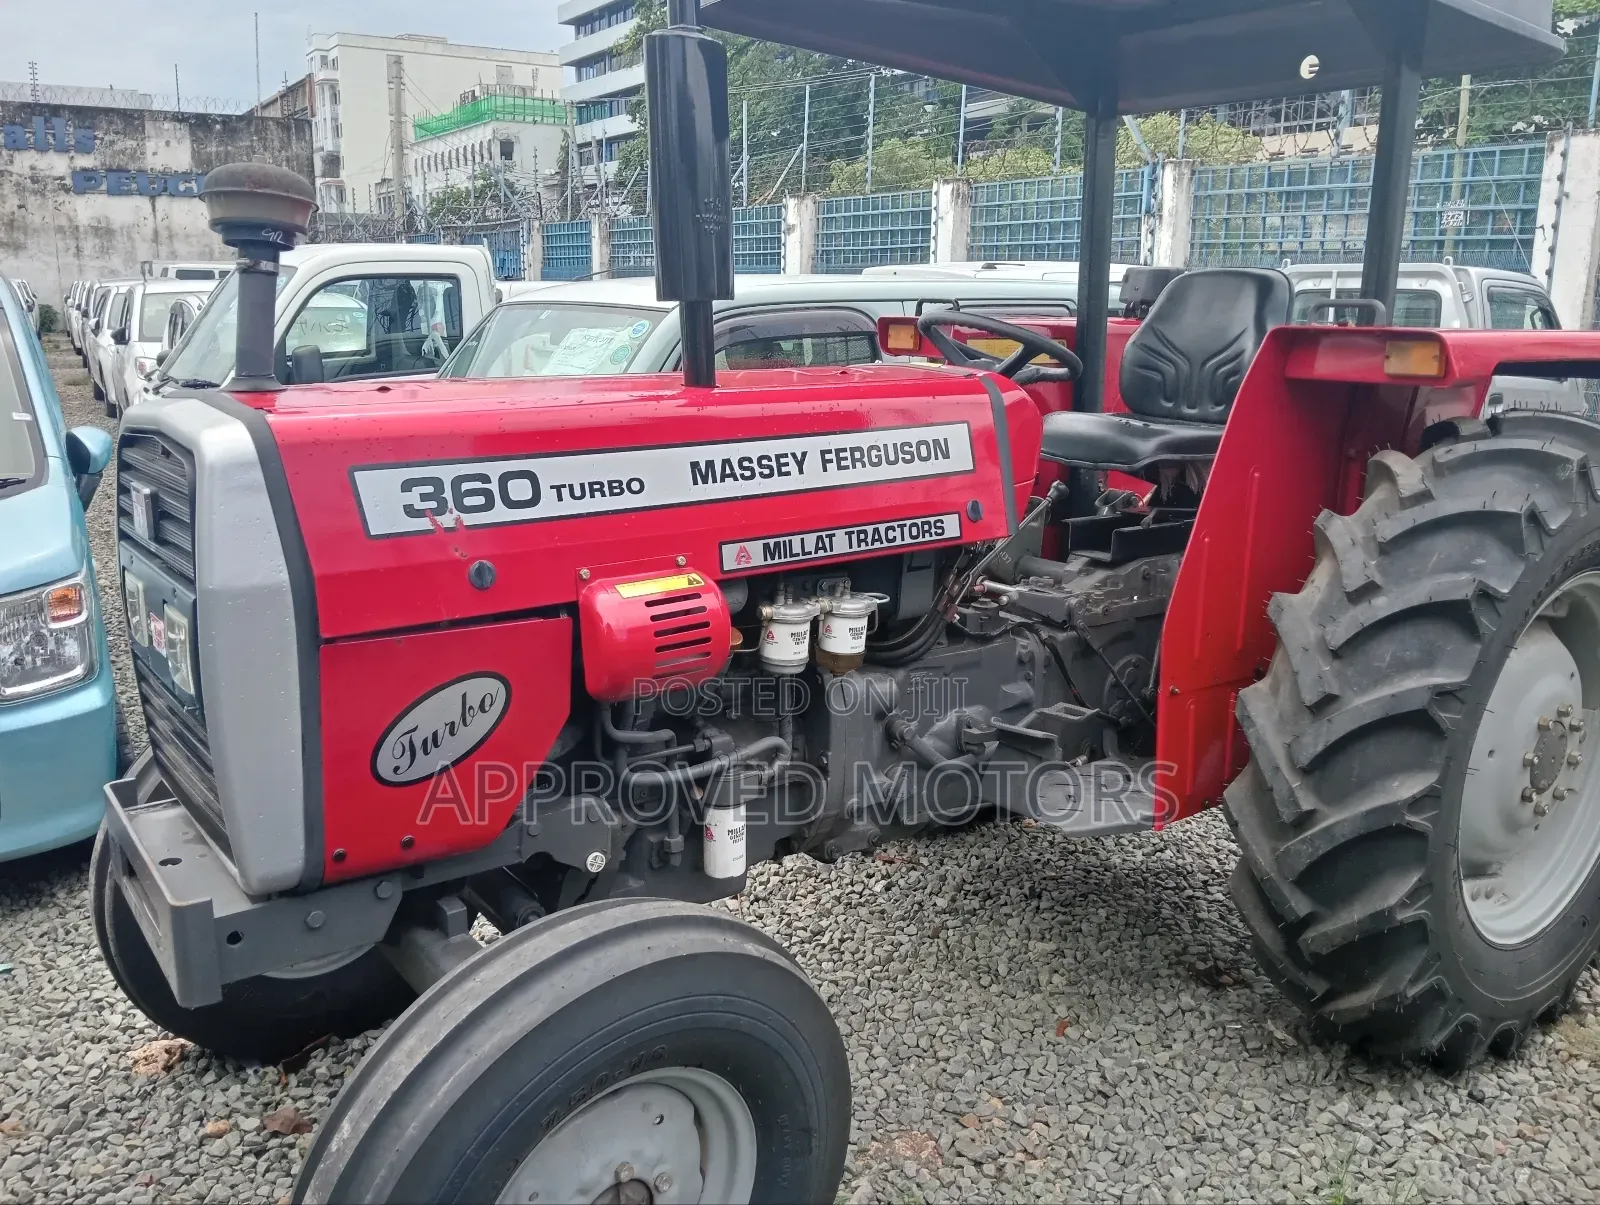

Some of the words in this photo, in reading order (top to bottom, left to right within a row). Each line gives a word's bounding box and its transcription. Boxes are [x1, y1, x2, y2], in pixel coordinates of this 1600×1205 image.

[689, 451, 808, 486] MASSEY
[820, 437, 950, 473] FERGUSON
[400, 469, 542, 519] 360
[549, 477, 646, 503] TURBO
[762, 532, 836, 562] MILLAT
[845, 518, 946, 550] TRACTORS
[392, 687, 500, 775] Turbo
